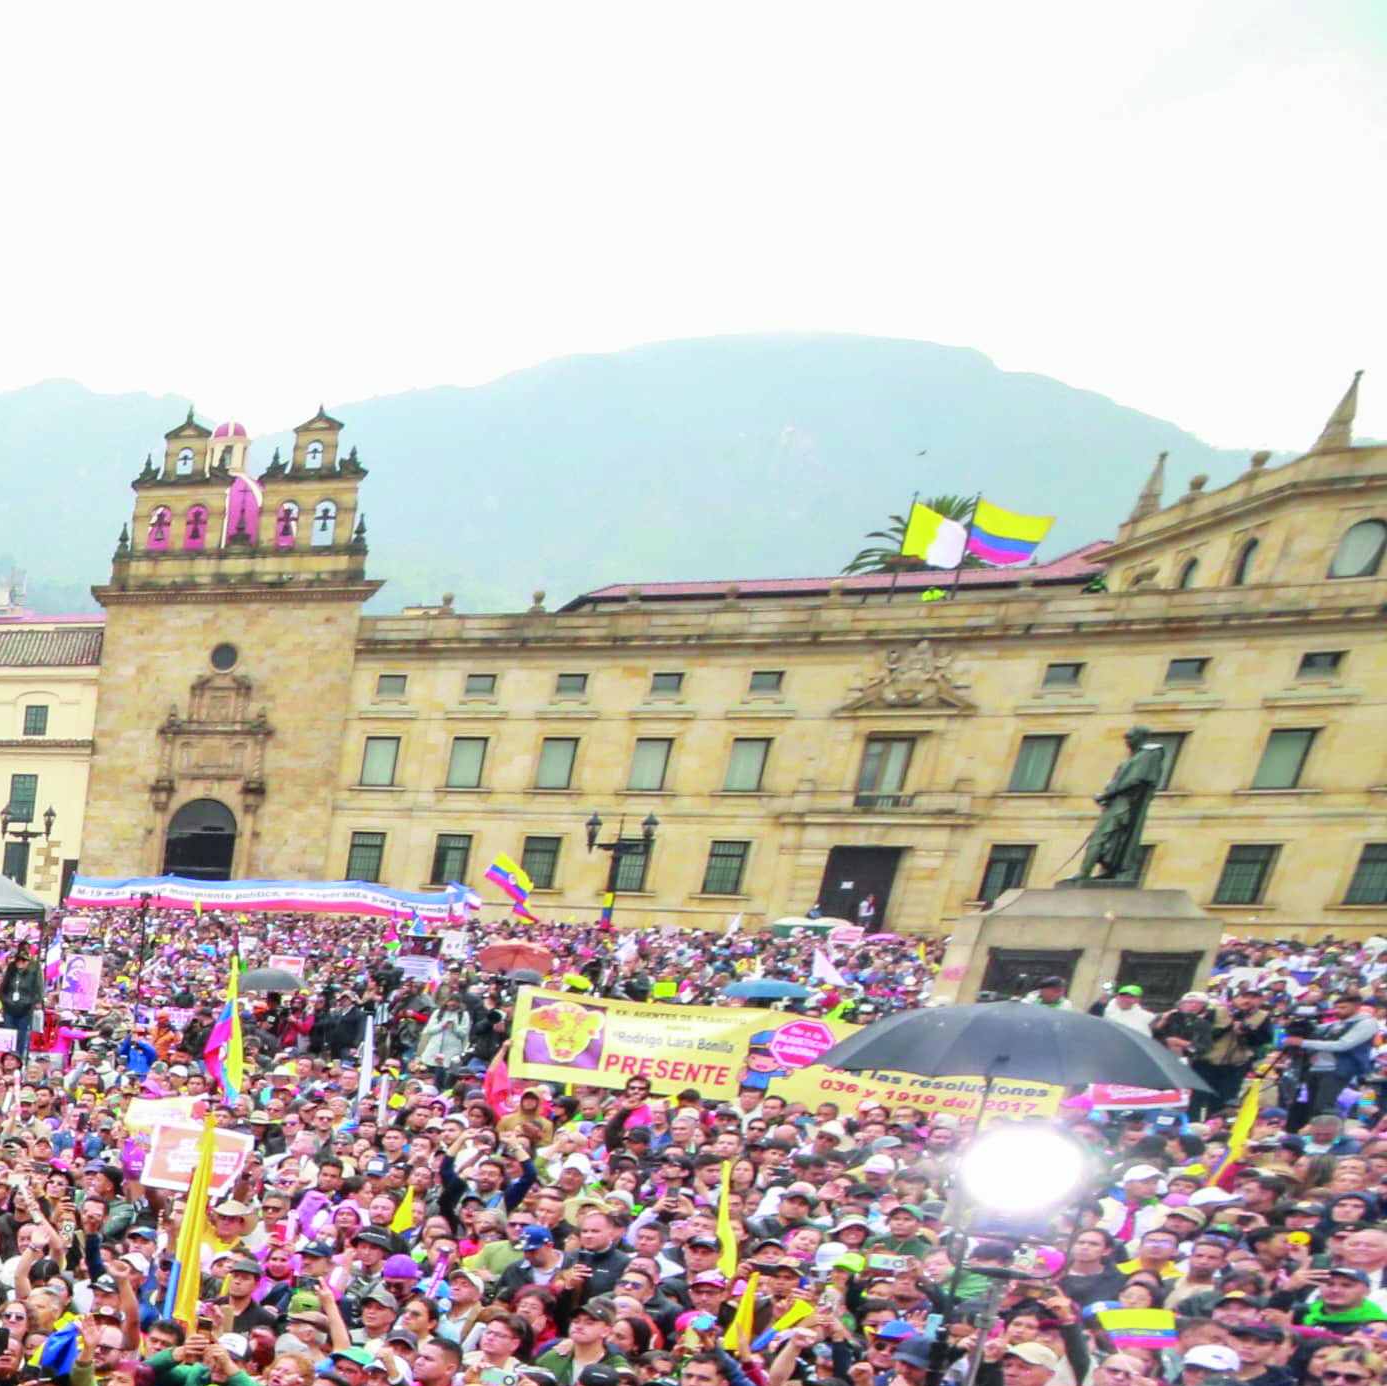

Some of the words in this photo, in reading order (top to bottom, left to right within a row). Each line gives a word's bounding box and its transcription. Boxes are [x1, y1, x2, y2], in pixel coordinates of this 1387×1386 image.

[169, 887, 232, 899] movimiento
[667, 1035, 693, 1049] Lara
[604, 1054, 731, 1086] PRESENTE
[870, 1070, 902, 1085] las
[909, 1077, 1050, 1098] resoluciones
[819, 1078, 859, 1094] 036
[861, 1089, 877, 1098] y
[885, 1089, 937, 1106] 1919
[942, 1092, 976, 1109] del
[984, 1099, 1039, 1114] 2017
